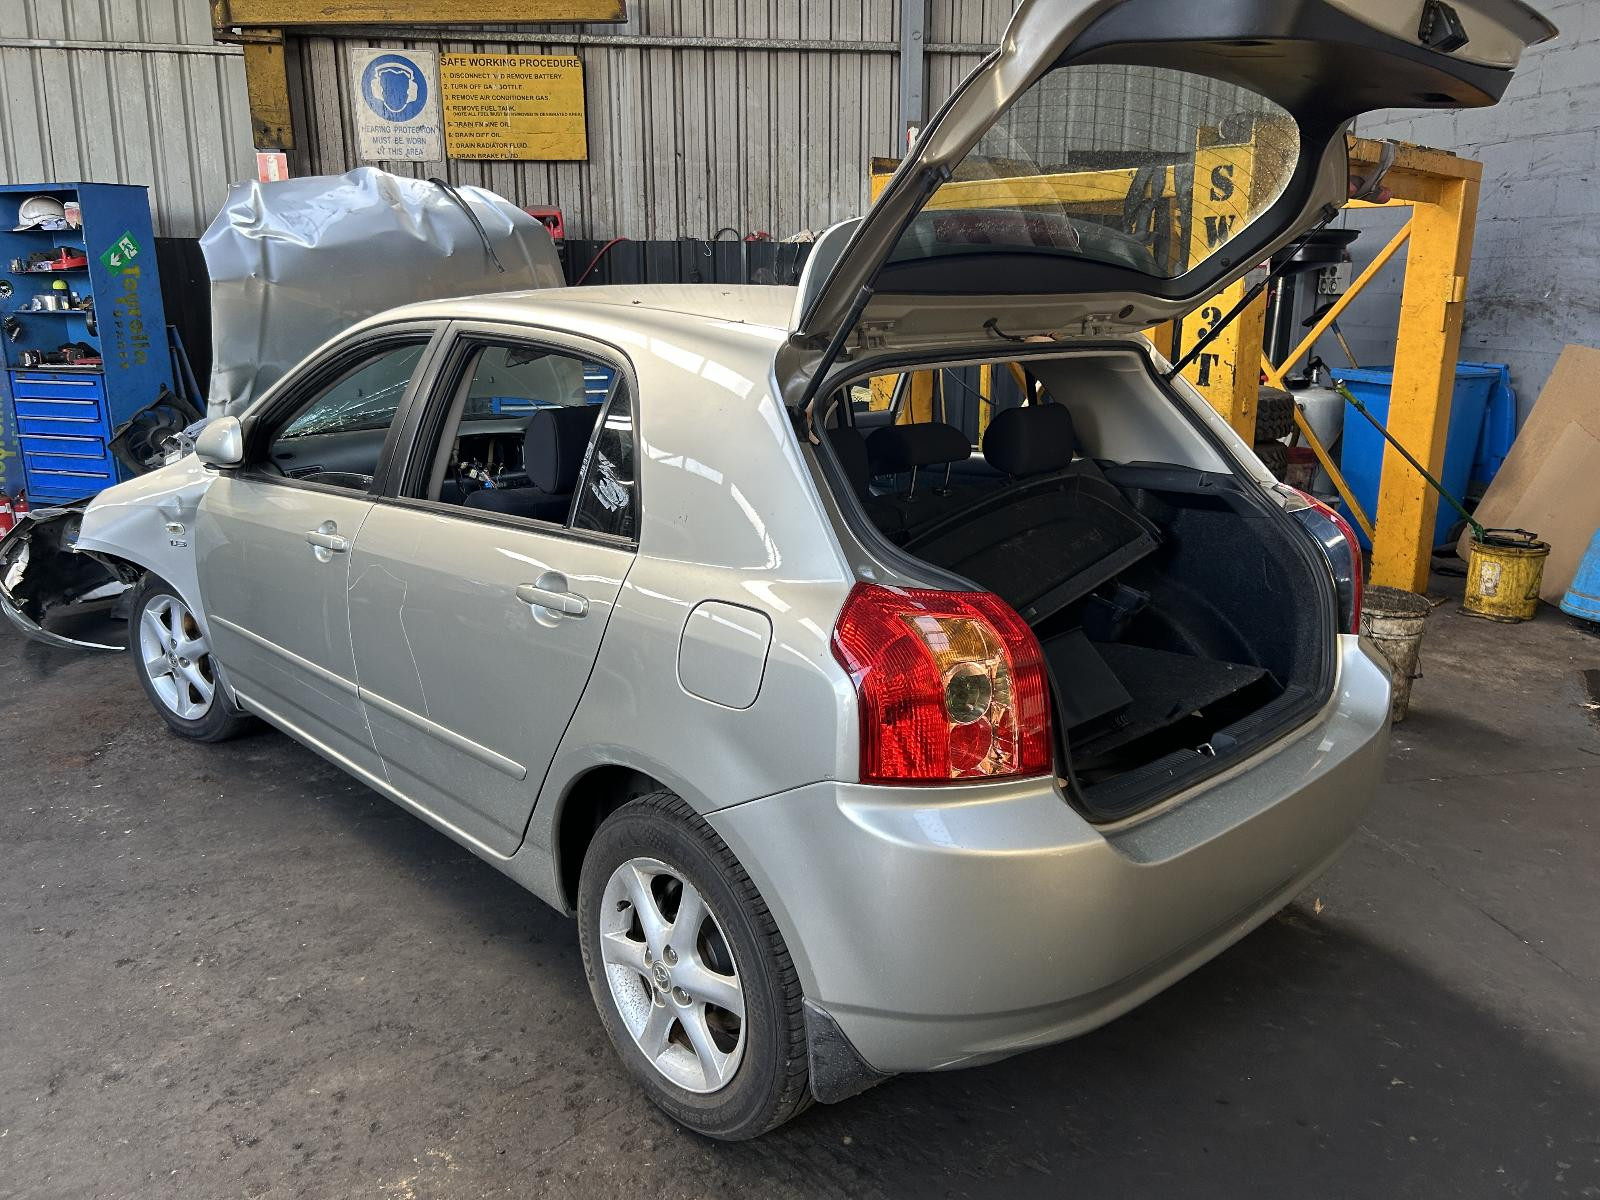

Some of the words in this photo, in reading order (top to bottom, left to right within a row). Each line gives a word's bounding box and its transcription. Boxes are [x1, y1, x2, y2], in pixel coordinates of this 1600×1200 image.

[440, 57, 466, 67] SAFE
[468, 58, 517, 67] WORKING
[519, 58, 580, 68] PROCEDURE
[361, 125, 391, 134] HEARING
[394, 125, 436, 134] PROTECTION
[372, 136, 391, 144] MUST
[394, 137, 404, 145] BE
[406, 137, 427, 145] WORN
[388, 147, 403, 155] THIS
[406, 147, 424, 156] AREA
